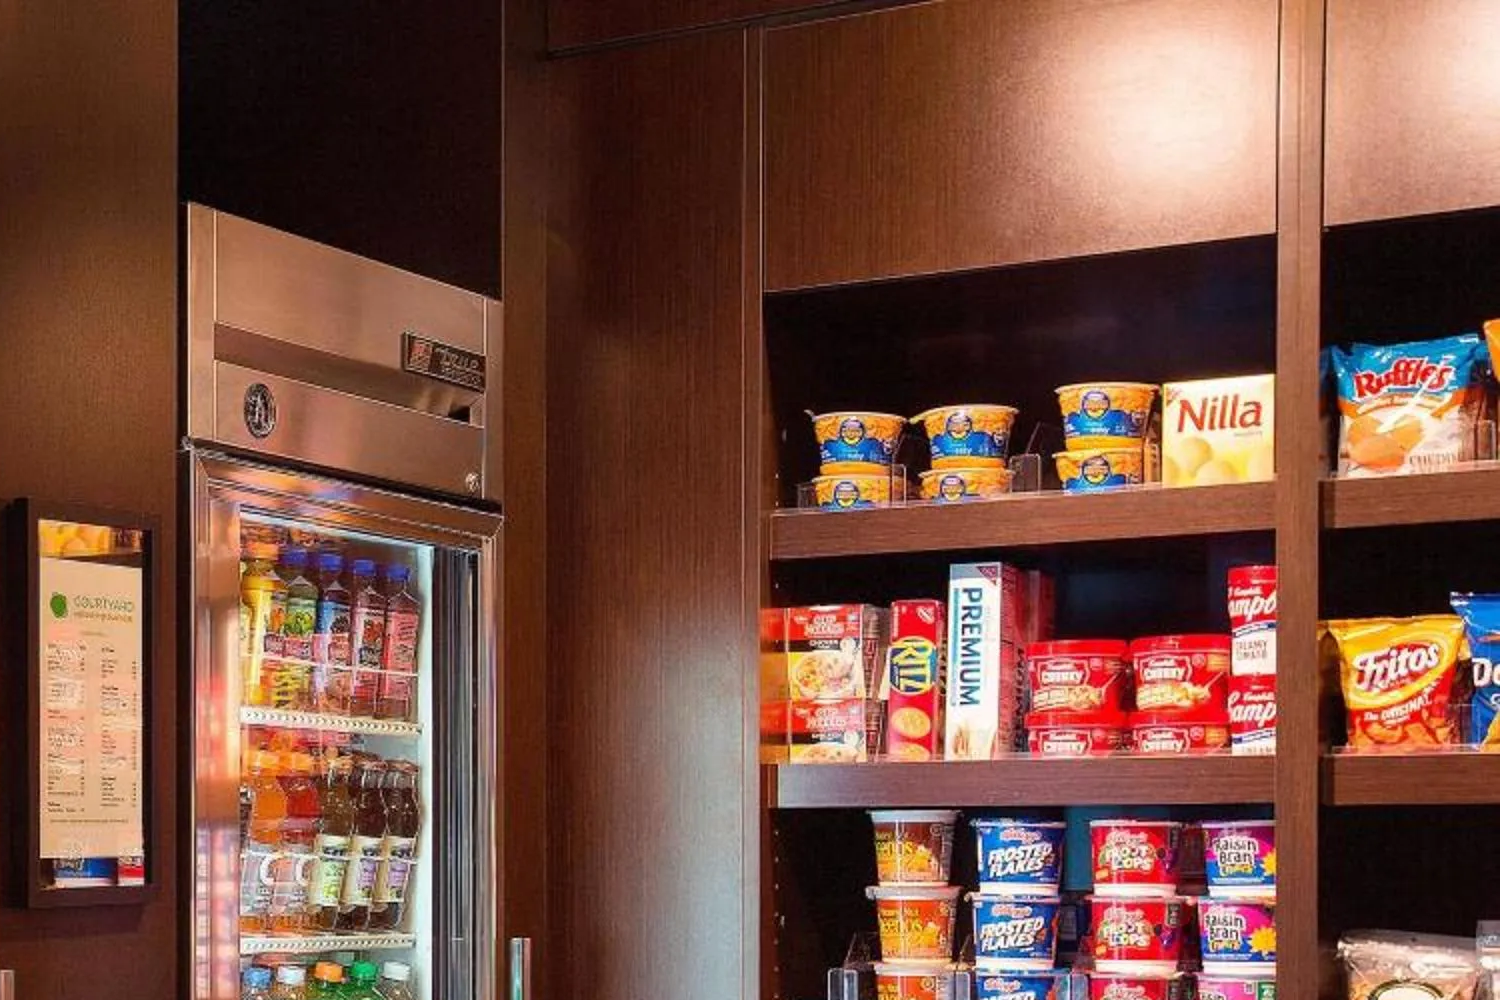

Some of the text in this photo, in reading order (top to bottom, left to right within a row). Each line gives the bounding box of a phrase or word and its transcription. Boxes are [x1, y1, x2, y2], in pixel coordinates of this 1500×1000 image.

[1354, 358, 1453, 398] Ruffles
[1177, 394, 1264, 433] Nilla
[959, 587, 984, 706] PREMIUM
[891, 639, 933, 693] RITZ
[1353, 645, 1439, 692] Fritos
[988, 842, 1053, 866] FROSTED
[1214, 837, 1258, 853] Raisin
[989, 857, 1046, 878] FLAKES
[1218, 850, 1253, 865] Bran
[980, 916, 1044, 939] FROSTED
[1204, 914, 1244, 929] Raisin
[1209, 925, 1242, 941] Bran
[981, 933, 1035, 953] FLAKES
